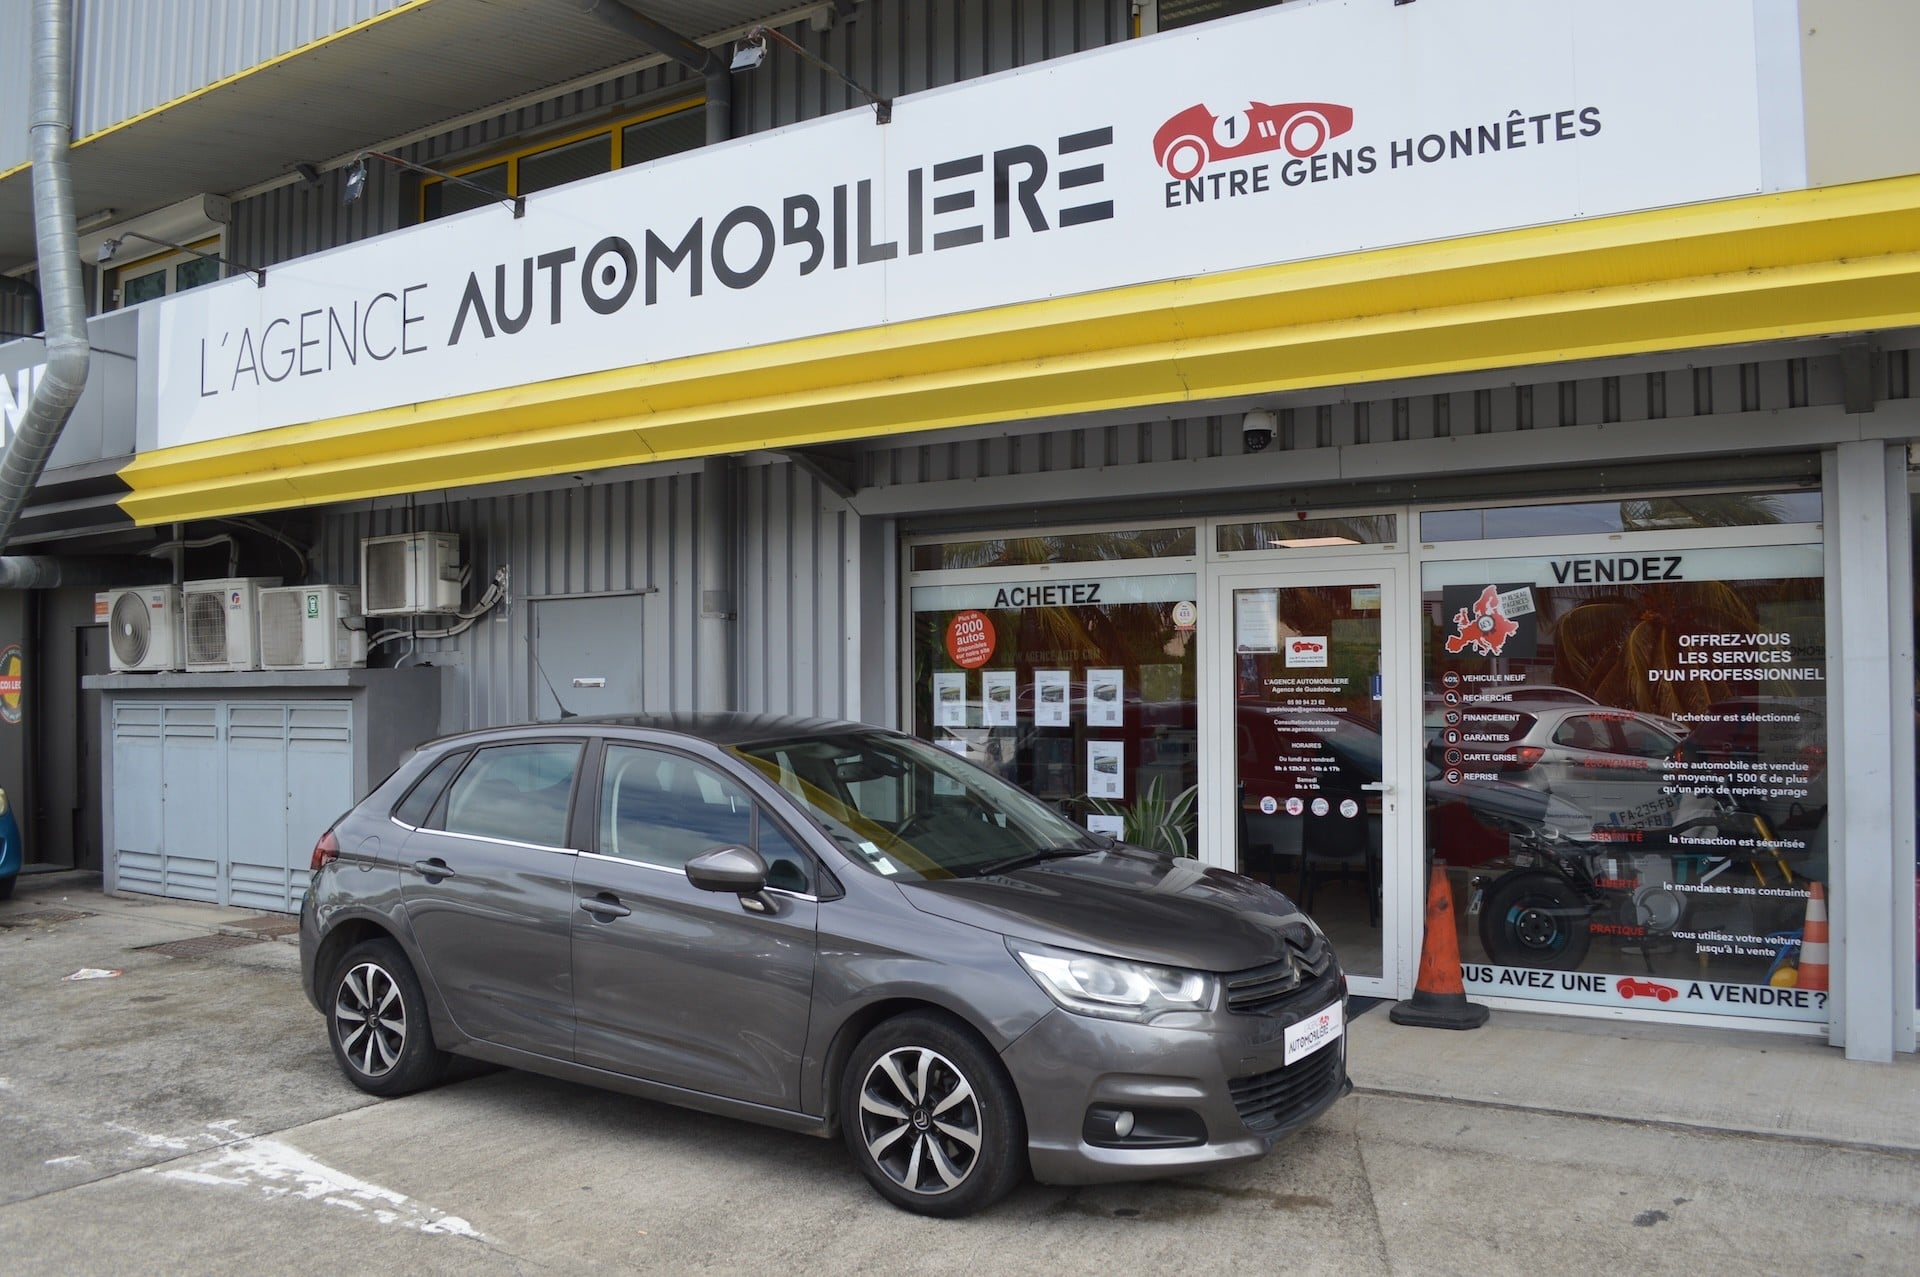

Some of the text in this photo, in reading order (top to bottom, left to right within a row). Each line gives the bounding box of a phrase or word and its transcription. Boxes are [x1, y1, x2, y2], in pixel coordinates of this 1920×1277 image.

[1165, 106, 1602, 209] ENTRE GENS HONNÊTES
[200, 125, 1114, 398] L'AGENCE AUTOMOBILIERE
[1550, 556, 1683, 584] VENDEZ
[994, 583, 1101, 608] ACHETEZ
[955, 619, 984, 636] 2000
[956, 632, 985, 646] autos
[1678, 633, 1791, 648] OFFREZ-VOUS
[1678, 652, 1708, 664] LES
[1711, 650, 1792, 664] SERVICES
[1462, 674, 1503, 682] VEHICULE
[1503, 674, 1527, 682] NEUF
[1648, 668, 1825, 682] D'UN PROFESSIONNEL
[1272, 686, 1295, 694] Agence
[1304, 686, 1341, 694] Guadeloupe
[1463, 694, 1513, 702] RECHERCHE
[1463, 714, 1521, 722] FINANCEMENT
[1671, 712, 1721, 722] l'acheteur
[1723, 714, 1743, 722] est
[1744, 712, 1801, 723] sélectionné
[1463, 753, 1518, 762] CARTE GRISE
[1662, 761, 1809, 771] votre automobile est vendue
[1463, 773, 1499, 781] REPRISE
[1662, 773, 1808, 787] en moyenne 1 500 € de plus
[1662, 786, 1808, 798] qu'un prix de reprise garage
[1669, 834, 1679, 844] la
[1680, 836, 1737, 847] transaction
[1738, 838, 1754, 847] est
[1756, 838, 1806, 849] sécurisée
[1663, 882, 1673, 891] le
[1675, 883, 1714, 893] mandat
[1715, 884, 1731, 893] est
[1733, 887, 1756, 895] sans
[1758, 887, 1812, 898] contrainte
[1589, 923, 1802, 946] PRATIQUE vous utilisez votre voiture
[1696, 942, 1776, 957] jusqu'à la vente
[1499, 969, 1555, 989] AVEZ
[1561, 974, 1607, 993] UNE
[1687, 982, 1704, 1000] A
[1709, 984, 1810, 1008] VENDRE
